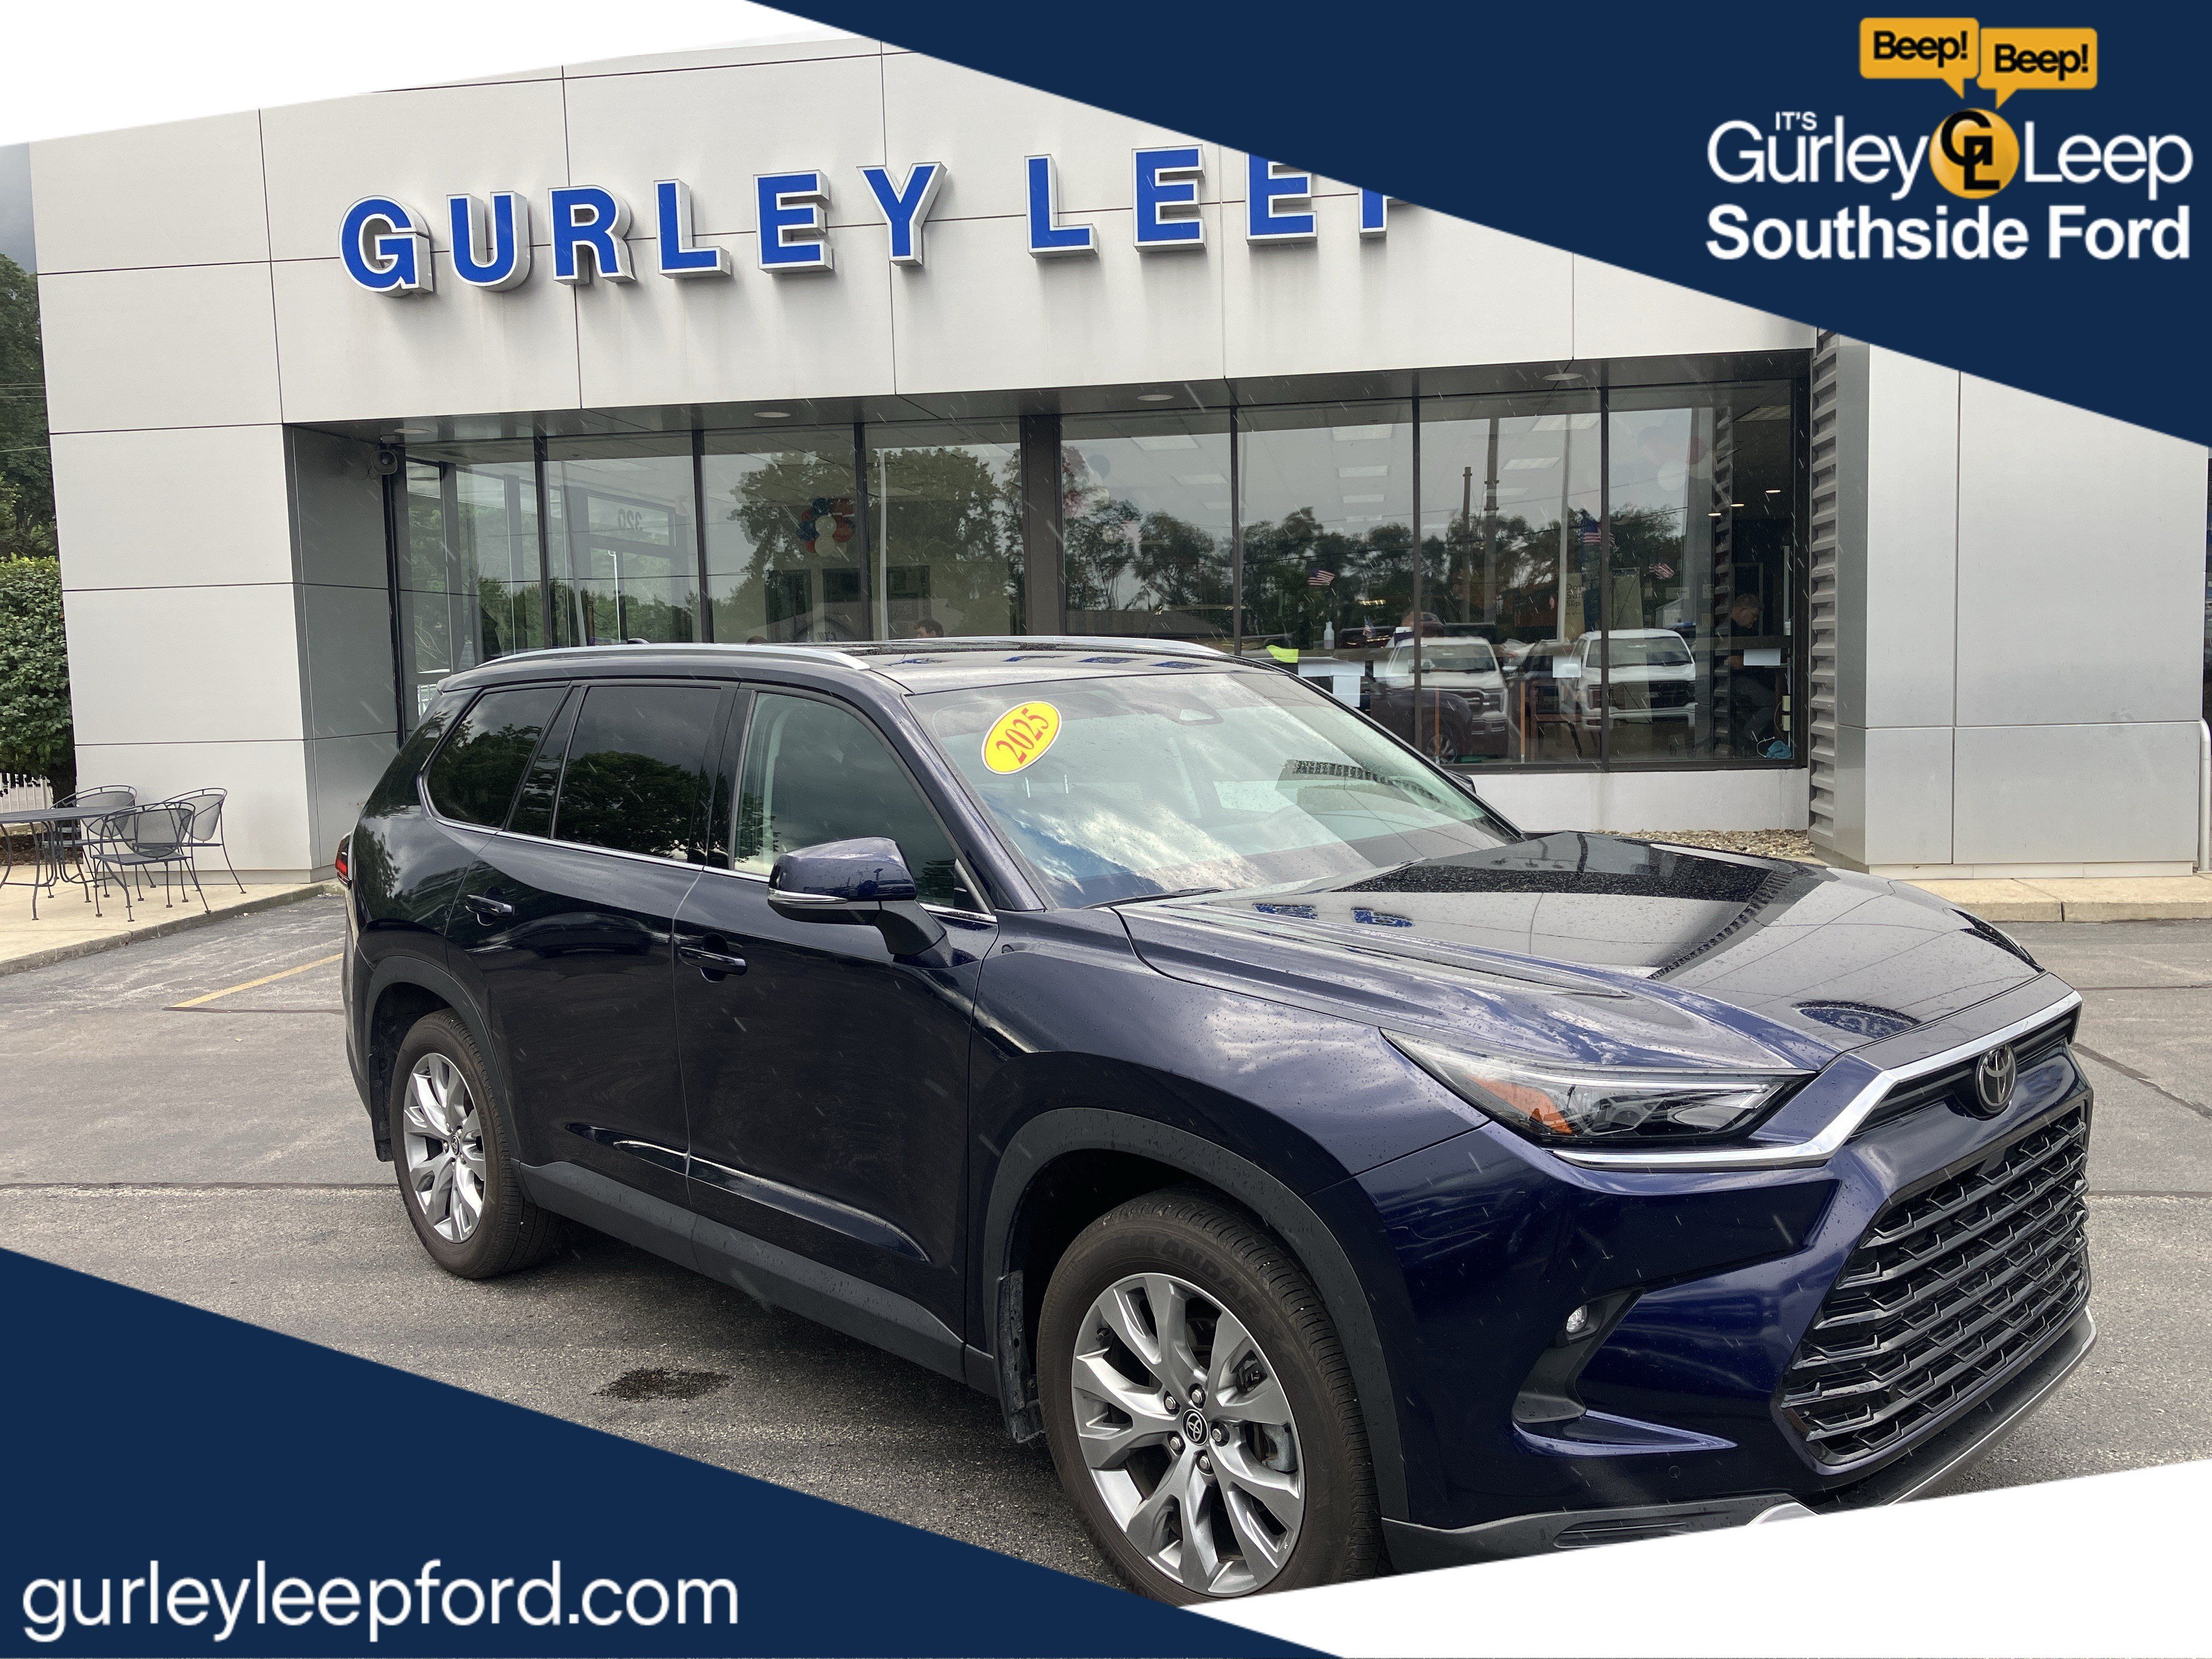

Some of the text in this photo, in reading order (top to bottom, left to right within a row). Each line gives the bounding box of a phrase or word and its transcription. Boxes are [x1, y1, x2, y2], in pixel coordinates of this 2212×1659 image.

[338, 144, 1404, 296] GURLEY LEE
[996, 708, 1049, 764] 2025
